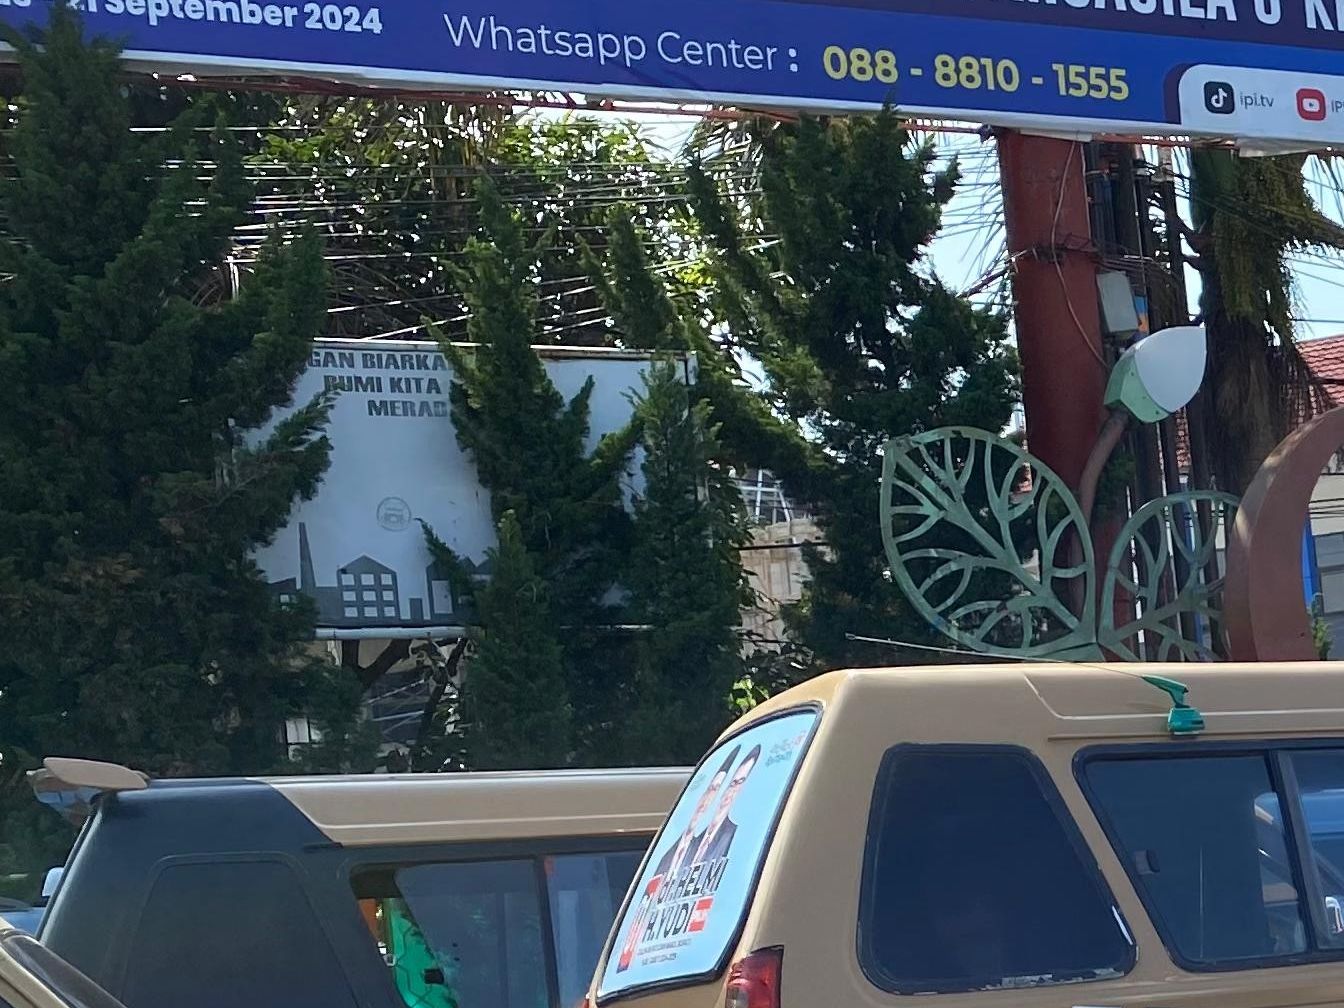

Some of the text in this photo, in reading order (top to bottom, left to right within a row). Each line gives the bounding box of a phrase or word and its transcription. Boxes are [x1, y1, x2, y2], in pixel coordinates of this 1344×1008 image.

[104, 0, 298, 27] September
[303, 6, 383, 34] 2024
[443, 13, 646, 67] Whatsapp
[657, 31, 777, 70] Center
[823, 45, 898, 84] 088
[934, 54, 1019, 92] 8810
[1052, 63, 1129, 101] 1555
[323, 375, 442, 394] BUMI KITA
